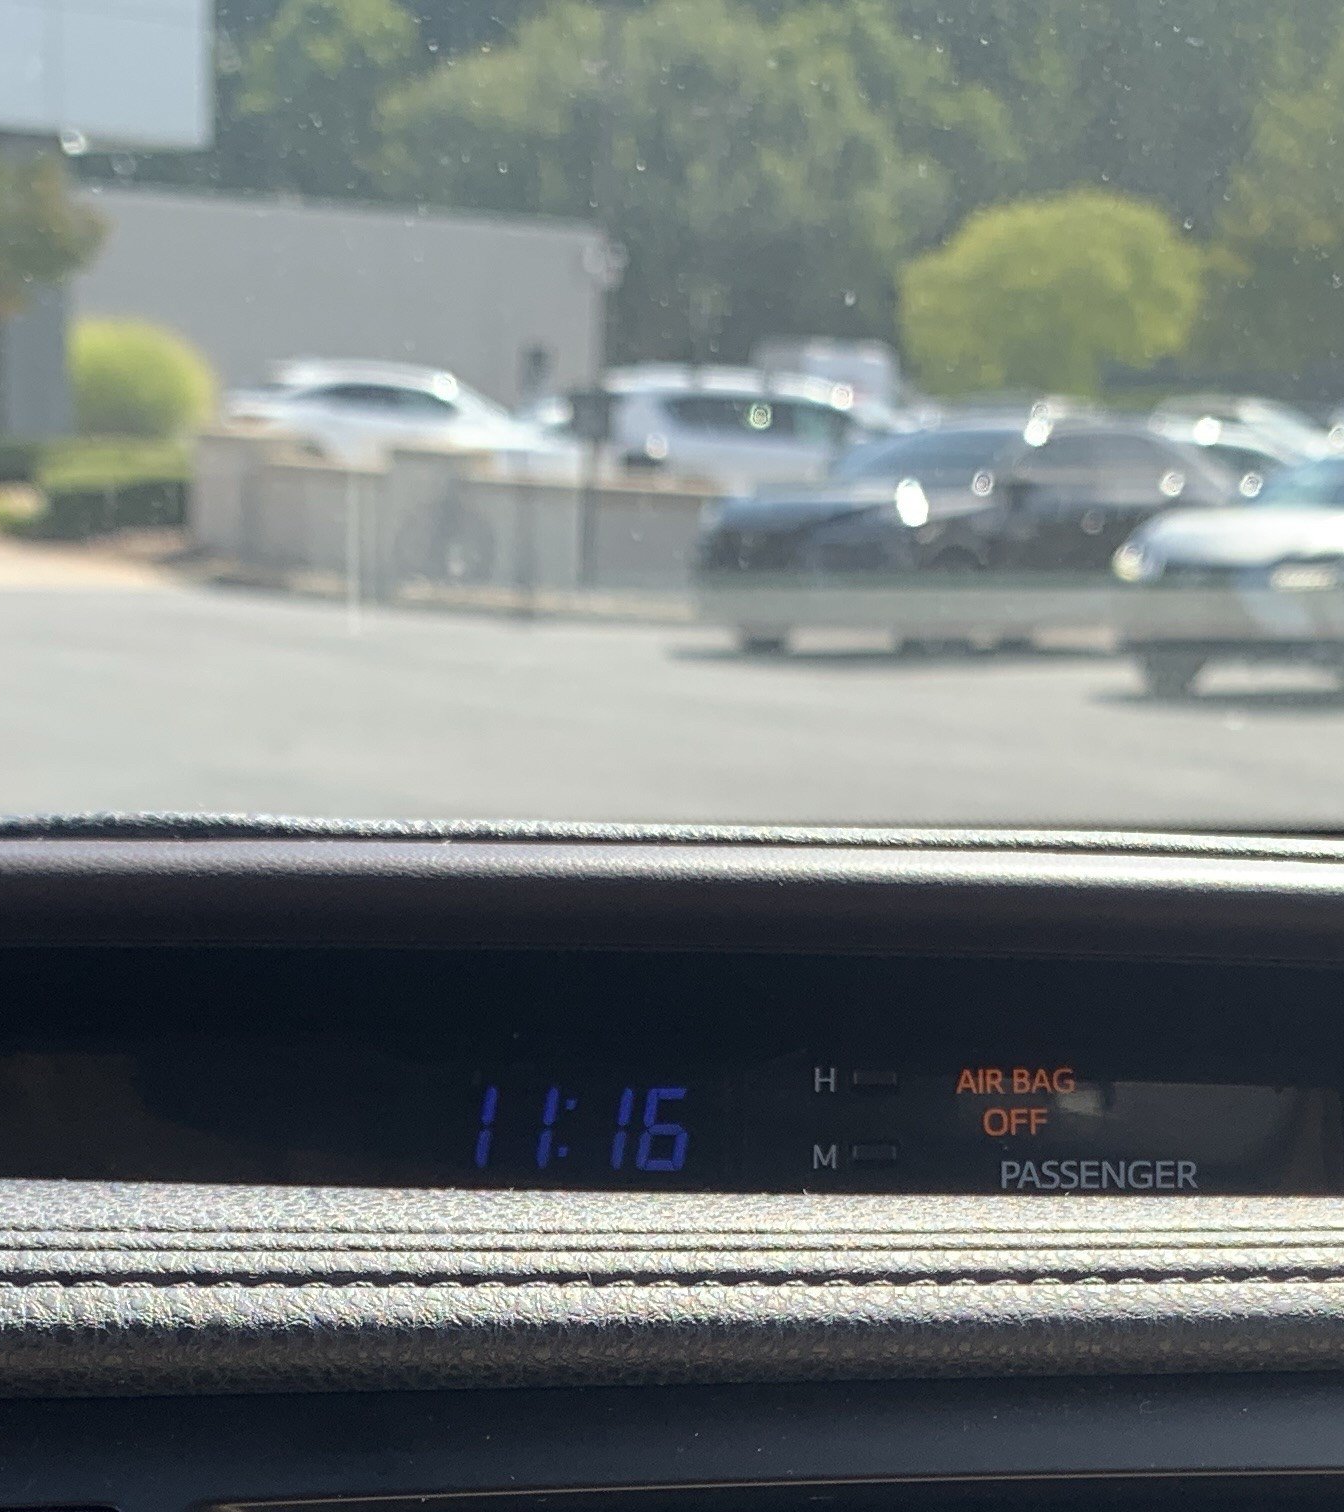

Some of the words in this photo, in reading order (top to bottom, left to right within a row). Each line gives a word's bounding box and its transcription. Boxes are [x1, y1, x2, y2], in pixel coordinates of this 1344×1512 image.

[815, 1068, 836, 1093] H
[956, 1068, 1006, 1095] AIR
[1012, 1067, 1075, 1095] BAG
[475, 1087, 687, 1171] 11:16
[983, 1107, 1048, 1137] OFF
[812, 1143, 837, 1169] M
[1001, 1159, 1198, 1189] PASSENGER
